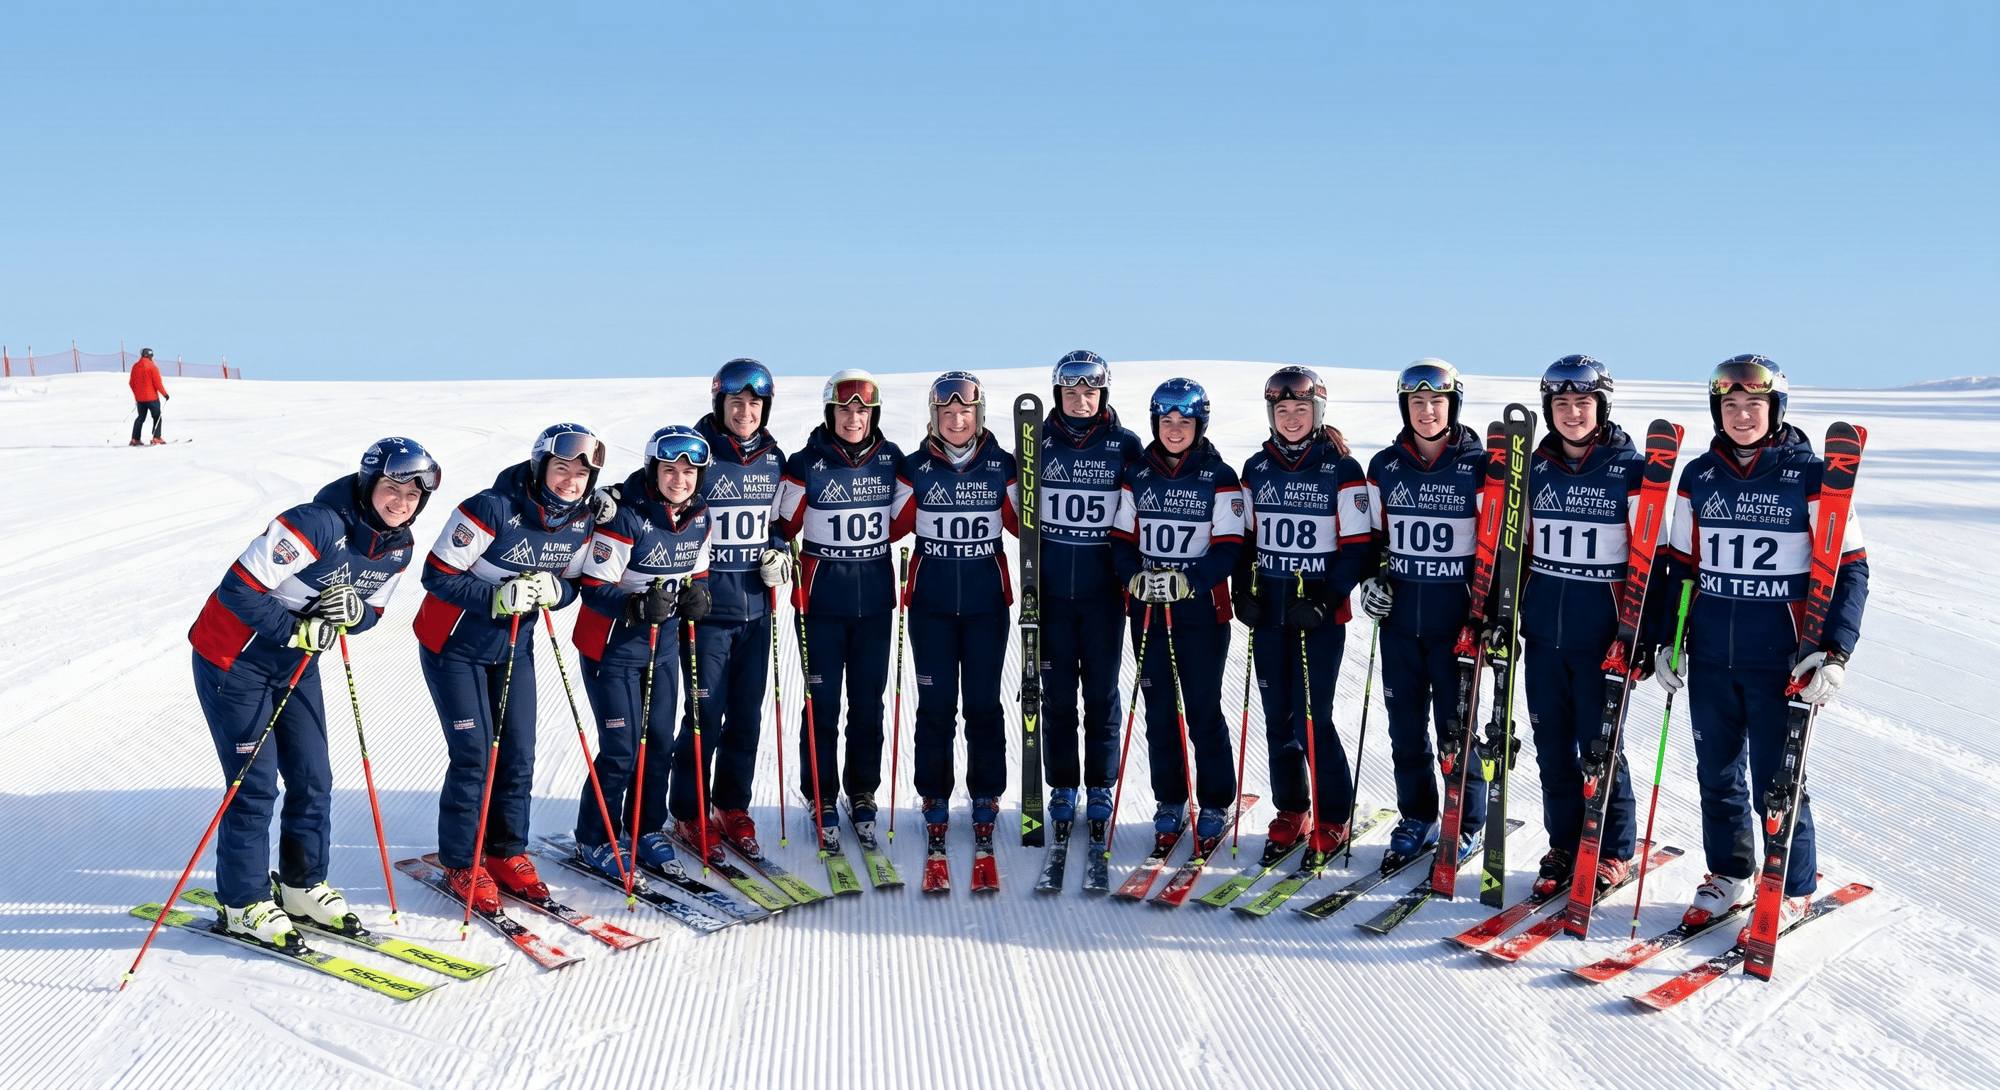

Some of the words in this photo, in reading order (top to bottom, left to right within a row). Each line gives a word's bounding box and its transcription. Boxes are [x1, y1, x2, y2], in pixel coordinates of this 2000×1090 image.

[1073, 459, 1106, 469] ALPINE
[742, 474, 770, 483] ALPINE
[1023, 422, 1035, 529] FISCHER
[1072, 468, 1116, 479] MASTERS
[852, 476, 882, 487] ALPINE
[955, 481, 988, 490] ALPINE
[1284, 481, 1319, 492] ALPINE
[955, 490, 998, 500] MASTERS
[1164, 488, 1199, 500] ALPINE
[1420, 483, 1455, 494] ALPINE
[1504, 434, 1526, 552] FISCHER
[1567, 485, 1606, 498] ALPINE
[1284, 490, 1329, 503] MASTERS
[1418, 492, 1466, 505] MASTERS
[1565, 495, 1617, 510] MASTERS
[1736, 491, 1780, 505] ALPINE
[1048, 493, 1106, 524] 105
[1163, 497, 1208, 510] MASTERS
[1283, 500, 1302, 508] RACE
[1303, 501, 1328, 510] SERIES
[1417, 502, 1438, 511] RACE
[1438, 503, 1464, 512] SERIES
[1735, 502, 1793, 518] MASTERS
[1162, 506, 1182, 514] RACE
[1182, 507, 1206, 516] SERIES
[1564, 505, 1587, 514] RACE
[1587, 507, 1616, 517] SERIES
[716, 510, 767, 540] 101
[827, 511, 883, 542] 103
[1759, 515, 1790, 525] SERIES
[932, 516, 990, 540] 106
[1261, 517, 1317, 550] 108
[1142, 523, 1197, 554] 107
[1393, 520, 1454, 553] 109
[1539, 524, 1598, 560] 111
[542, 541, 573, 552] ALPINE
[675, 540, 700, 552] ALPINE
[924, 541, 948, 557] SKI
[953, 542, 995, 557] TEAM
[1707, 533, 1779, 571] 112
[674, 550, 700, 561] MASTER
[709, 548, 734, 563] SKI
[739, 547, 765, 563] TEA
[1256, 551, 1274, 570] SKI
[1278, 556, 1326, 573] TEAM
[1389, 556, 1409, 574] SKI
[1415, 560, 1464, 577] TEAM
[1700, 572, 1722, 593] SKI
[1729, 578, 1789, 597] TEAM
[402, 948, 477, 973] FISCHER
[343, 967, 421, 993] FISCHER
